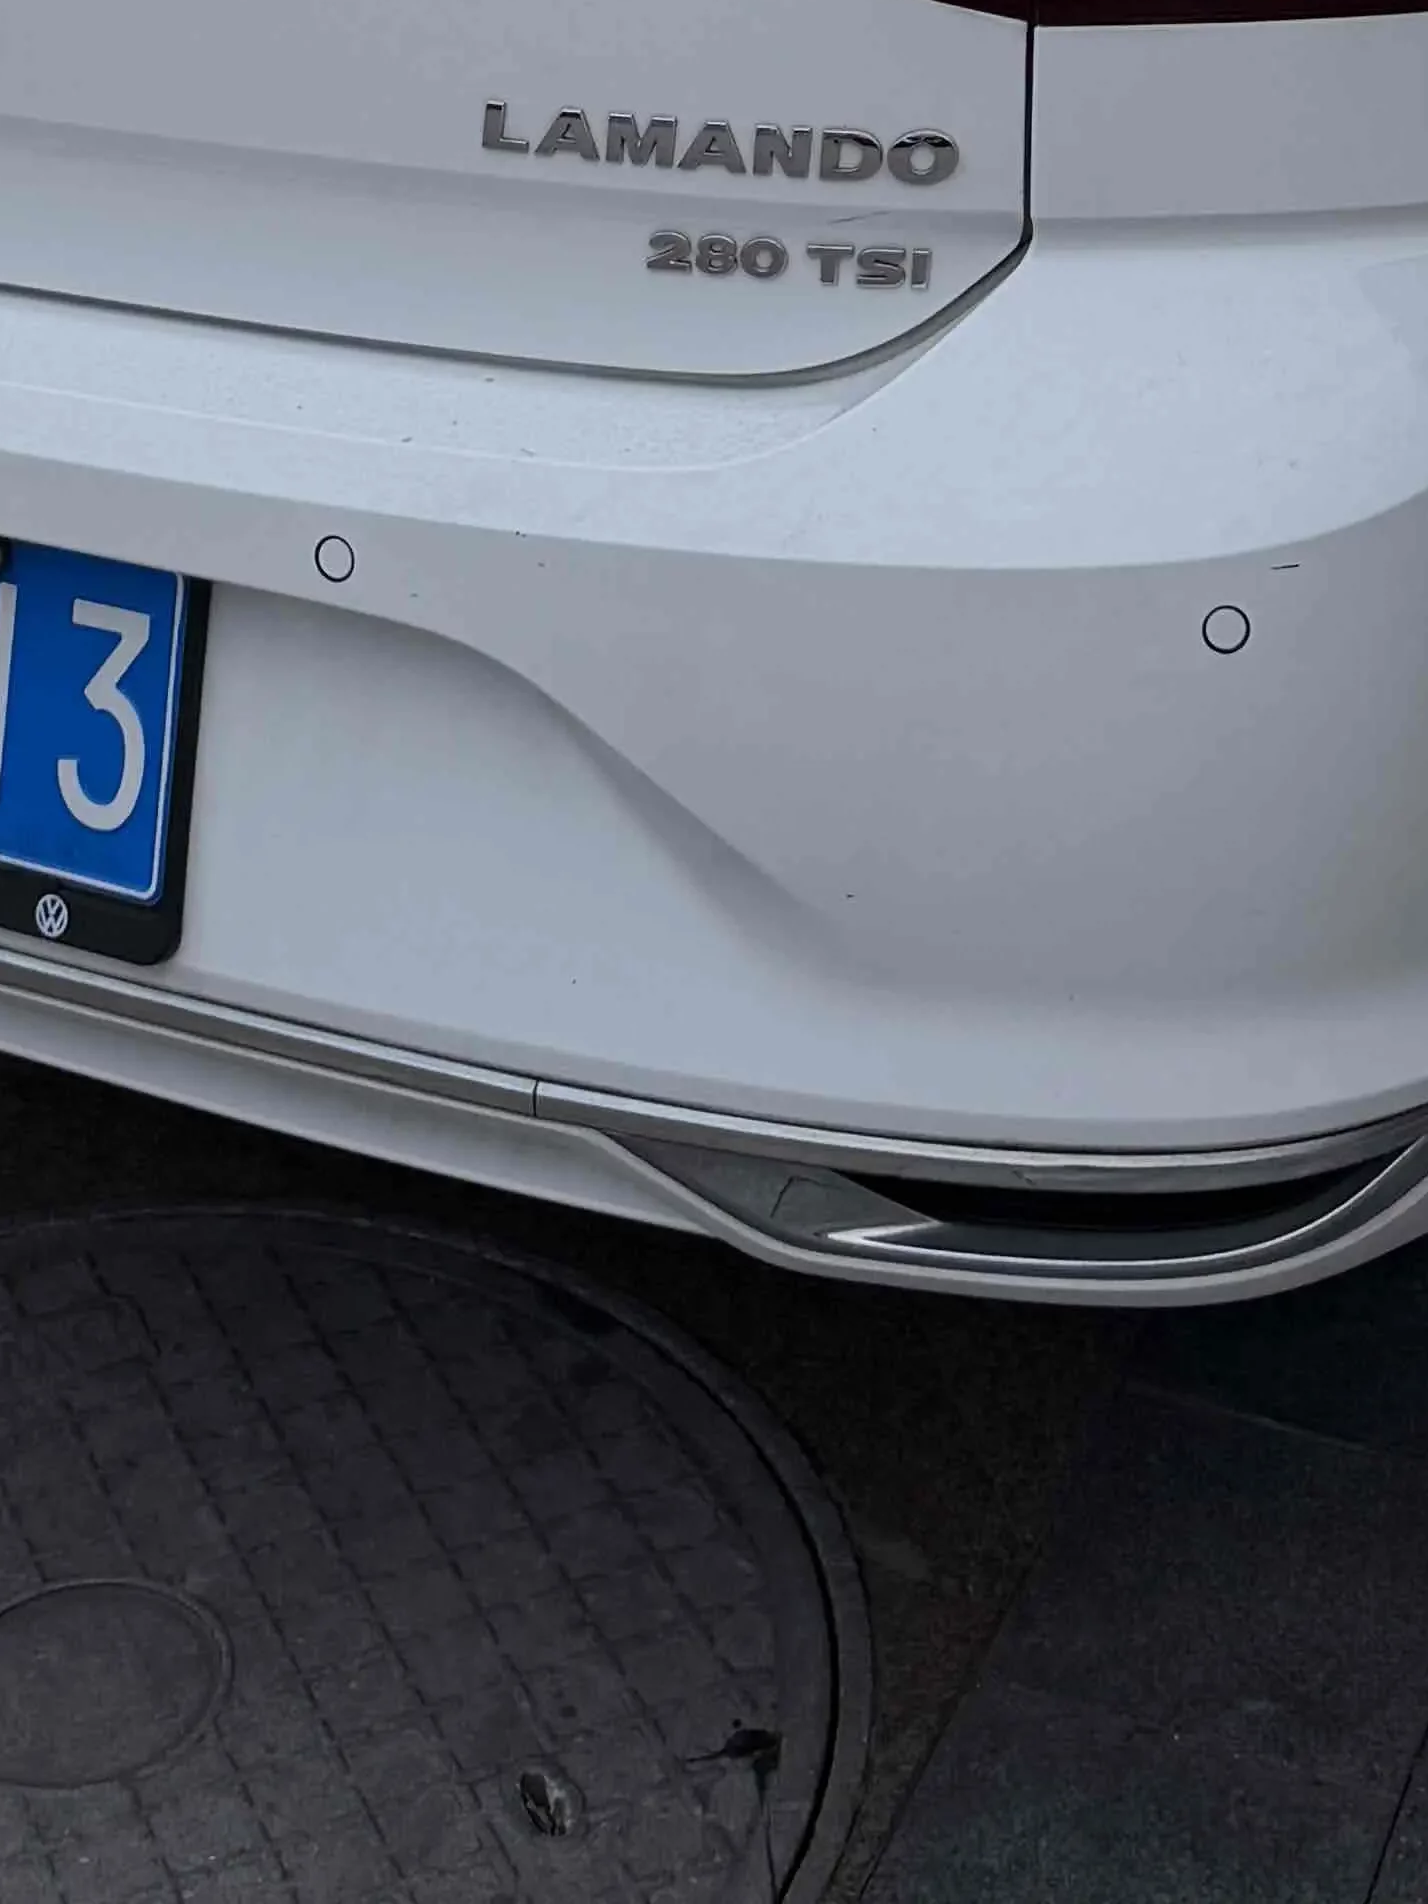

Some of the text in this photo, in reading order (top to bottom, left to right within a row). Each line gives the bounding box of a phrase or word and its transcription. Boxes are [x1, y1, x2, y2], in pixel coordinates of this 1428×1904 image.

[480, 98, 960, 186] LAMANDO
[645, 229, 932, 291] 280 TSI
